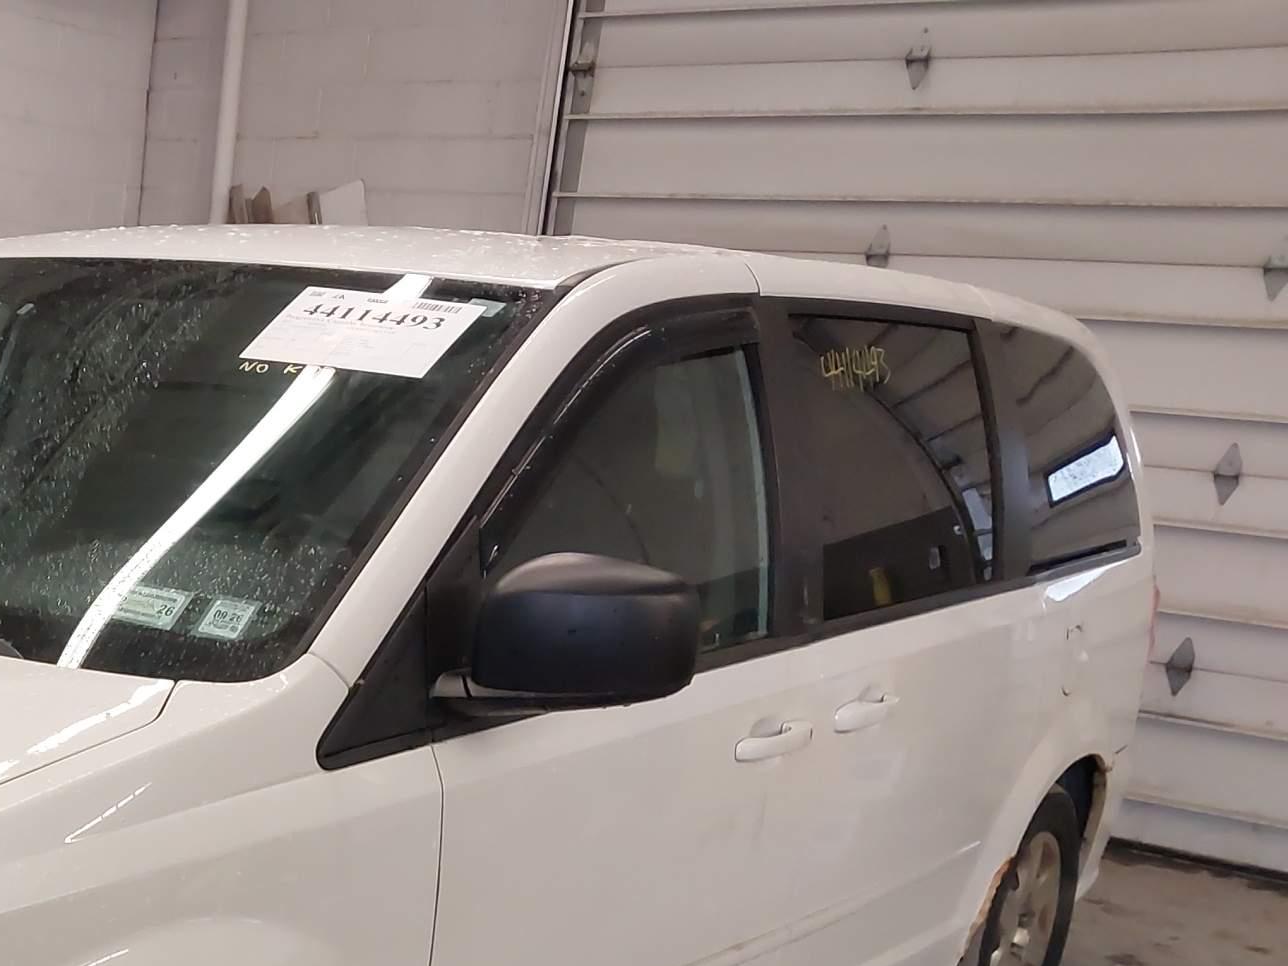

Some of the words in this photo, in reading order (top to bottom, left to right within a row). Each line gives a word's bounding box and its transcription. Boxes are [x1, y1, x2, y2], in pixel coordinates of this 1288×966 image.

[303, 303, 445, 330] 44114493
[239, 361, 269, 373] NO
[156, 605, 175, 617] 26
